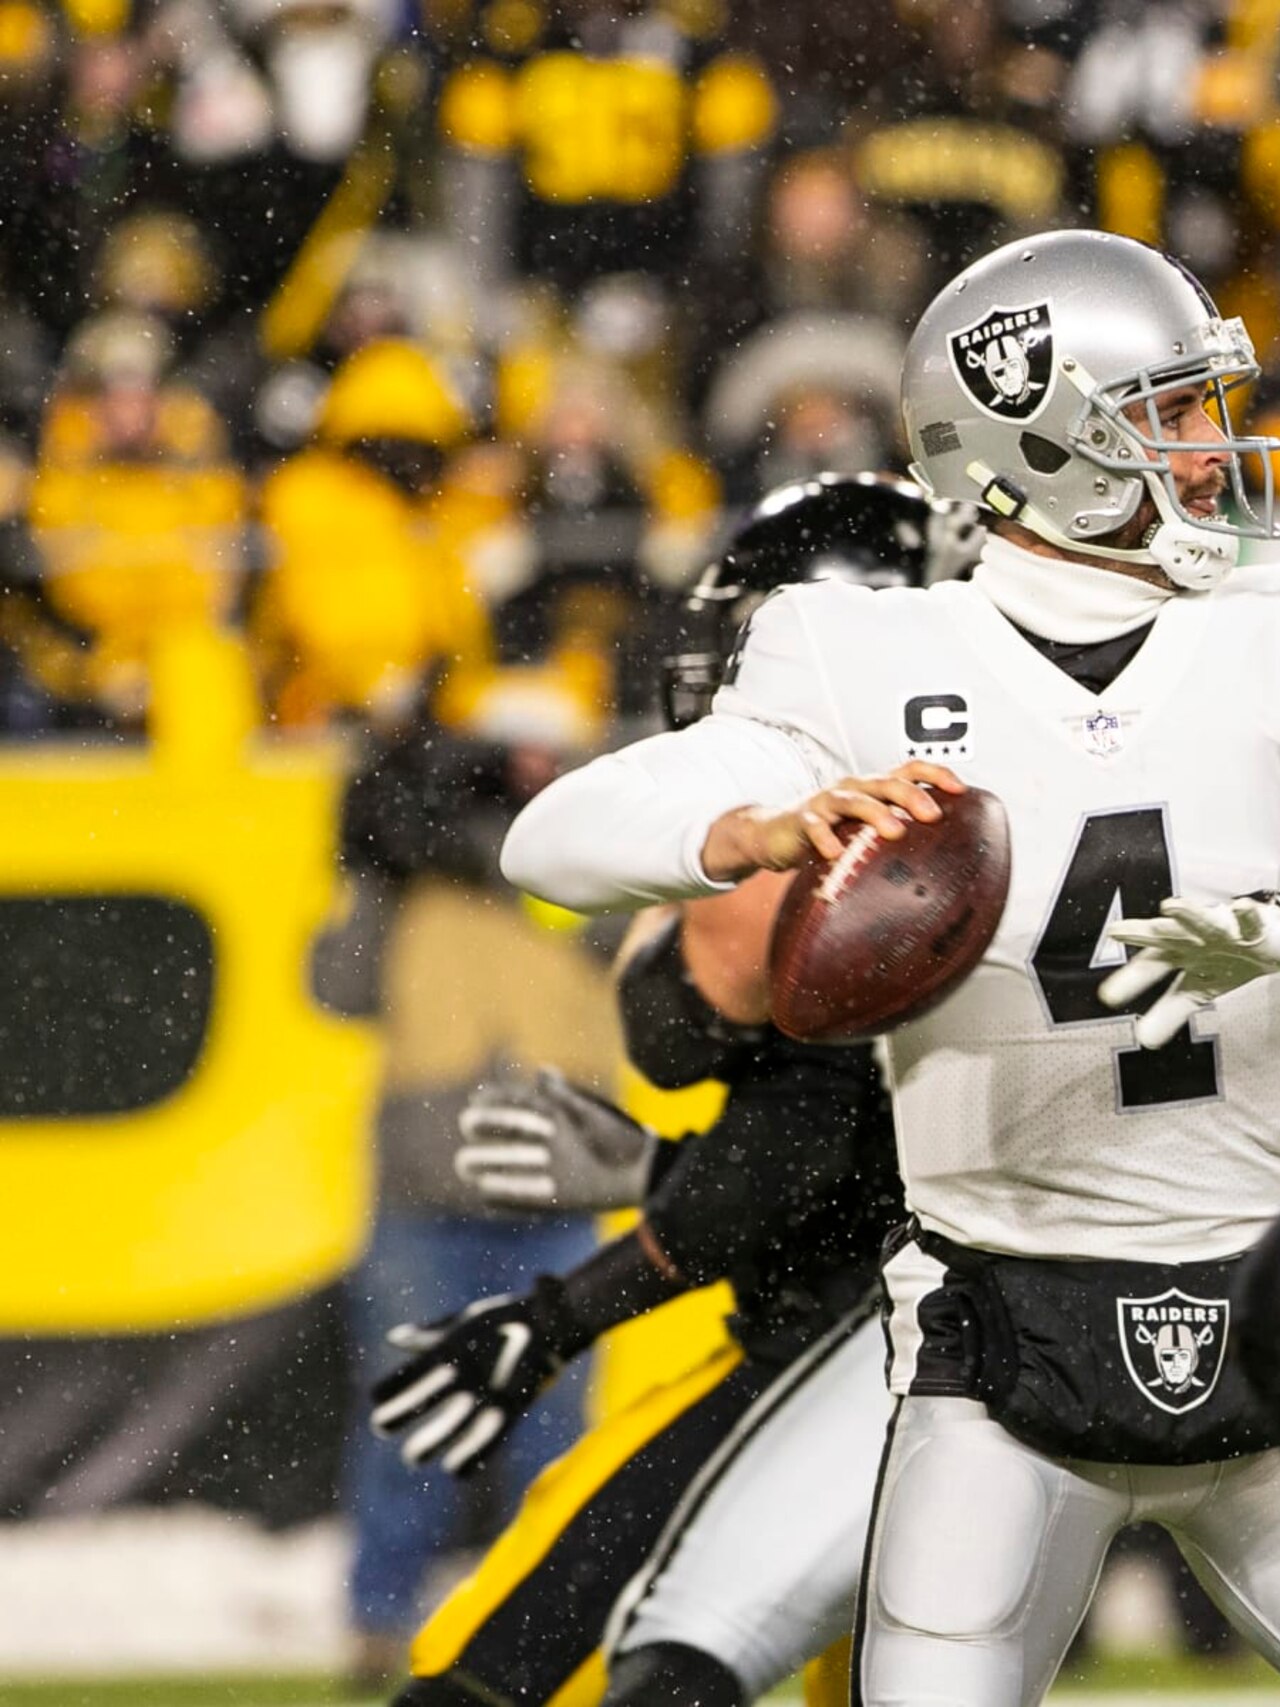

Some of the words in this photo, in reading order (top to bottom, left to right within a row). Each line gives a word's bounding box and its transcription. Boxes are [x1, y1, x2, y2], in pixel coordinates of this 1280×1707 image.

[959, 308, 1040, 349] RAIDERS
[904, 694, 968, 743] C
[1026, 801, 1226, 1115] 4
[1130, 1306, 1219, 1323] RAIDERS
